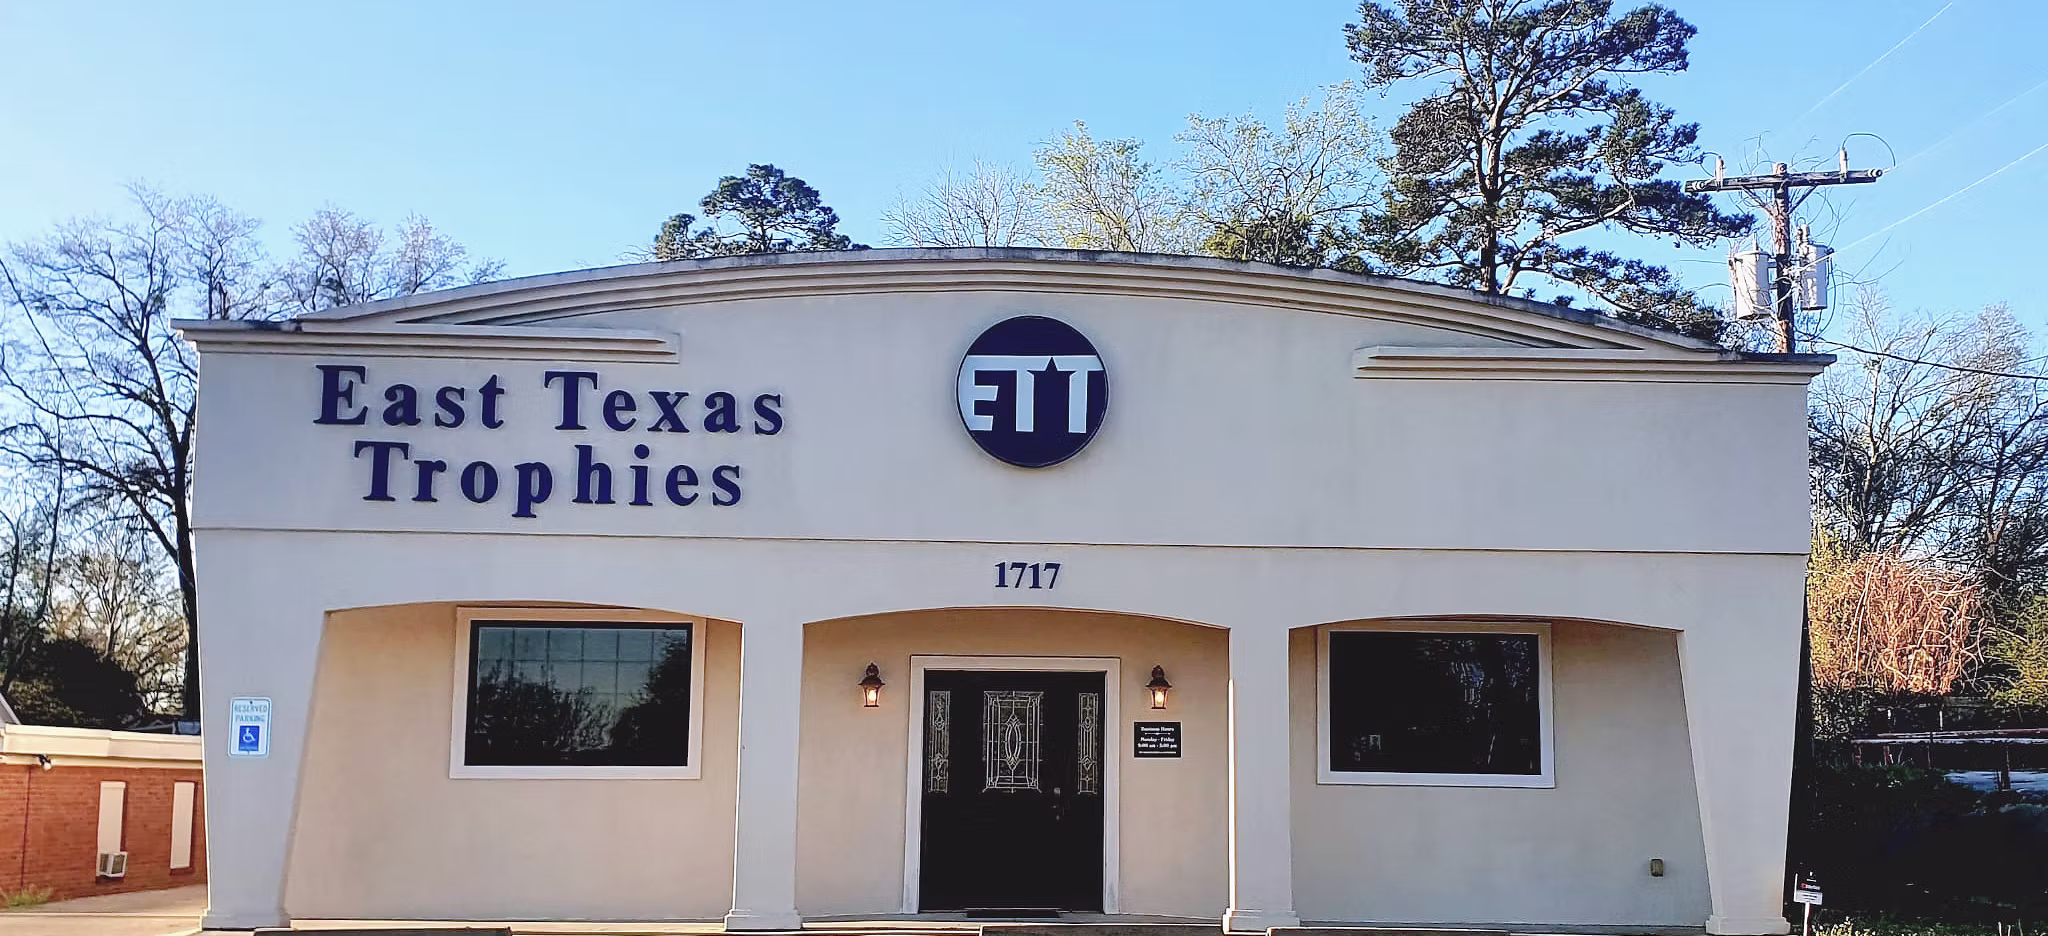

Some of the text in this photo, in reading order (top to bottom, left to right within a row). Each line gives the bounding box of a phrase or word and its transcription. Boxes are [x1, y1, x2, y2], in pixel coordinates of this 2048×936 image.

[313, 364, 784, 436] East Texas
[957, 354, 1105, 433] ETT
[354, 440, 742, 519] Trophies
[994, 561, 1061, 590] 1717
[234, 704, 268, 713] RESERVED
[235, 714, 265, 722] PARKING
